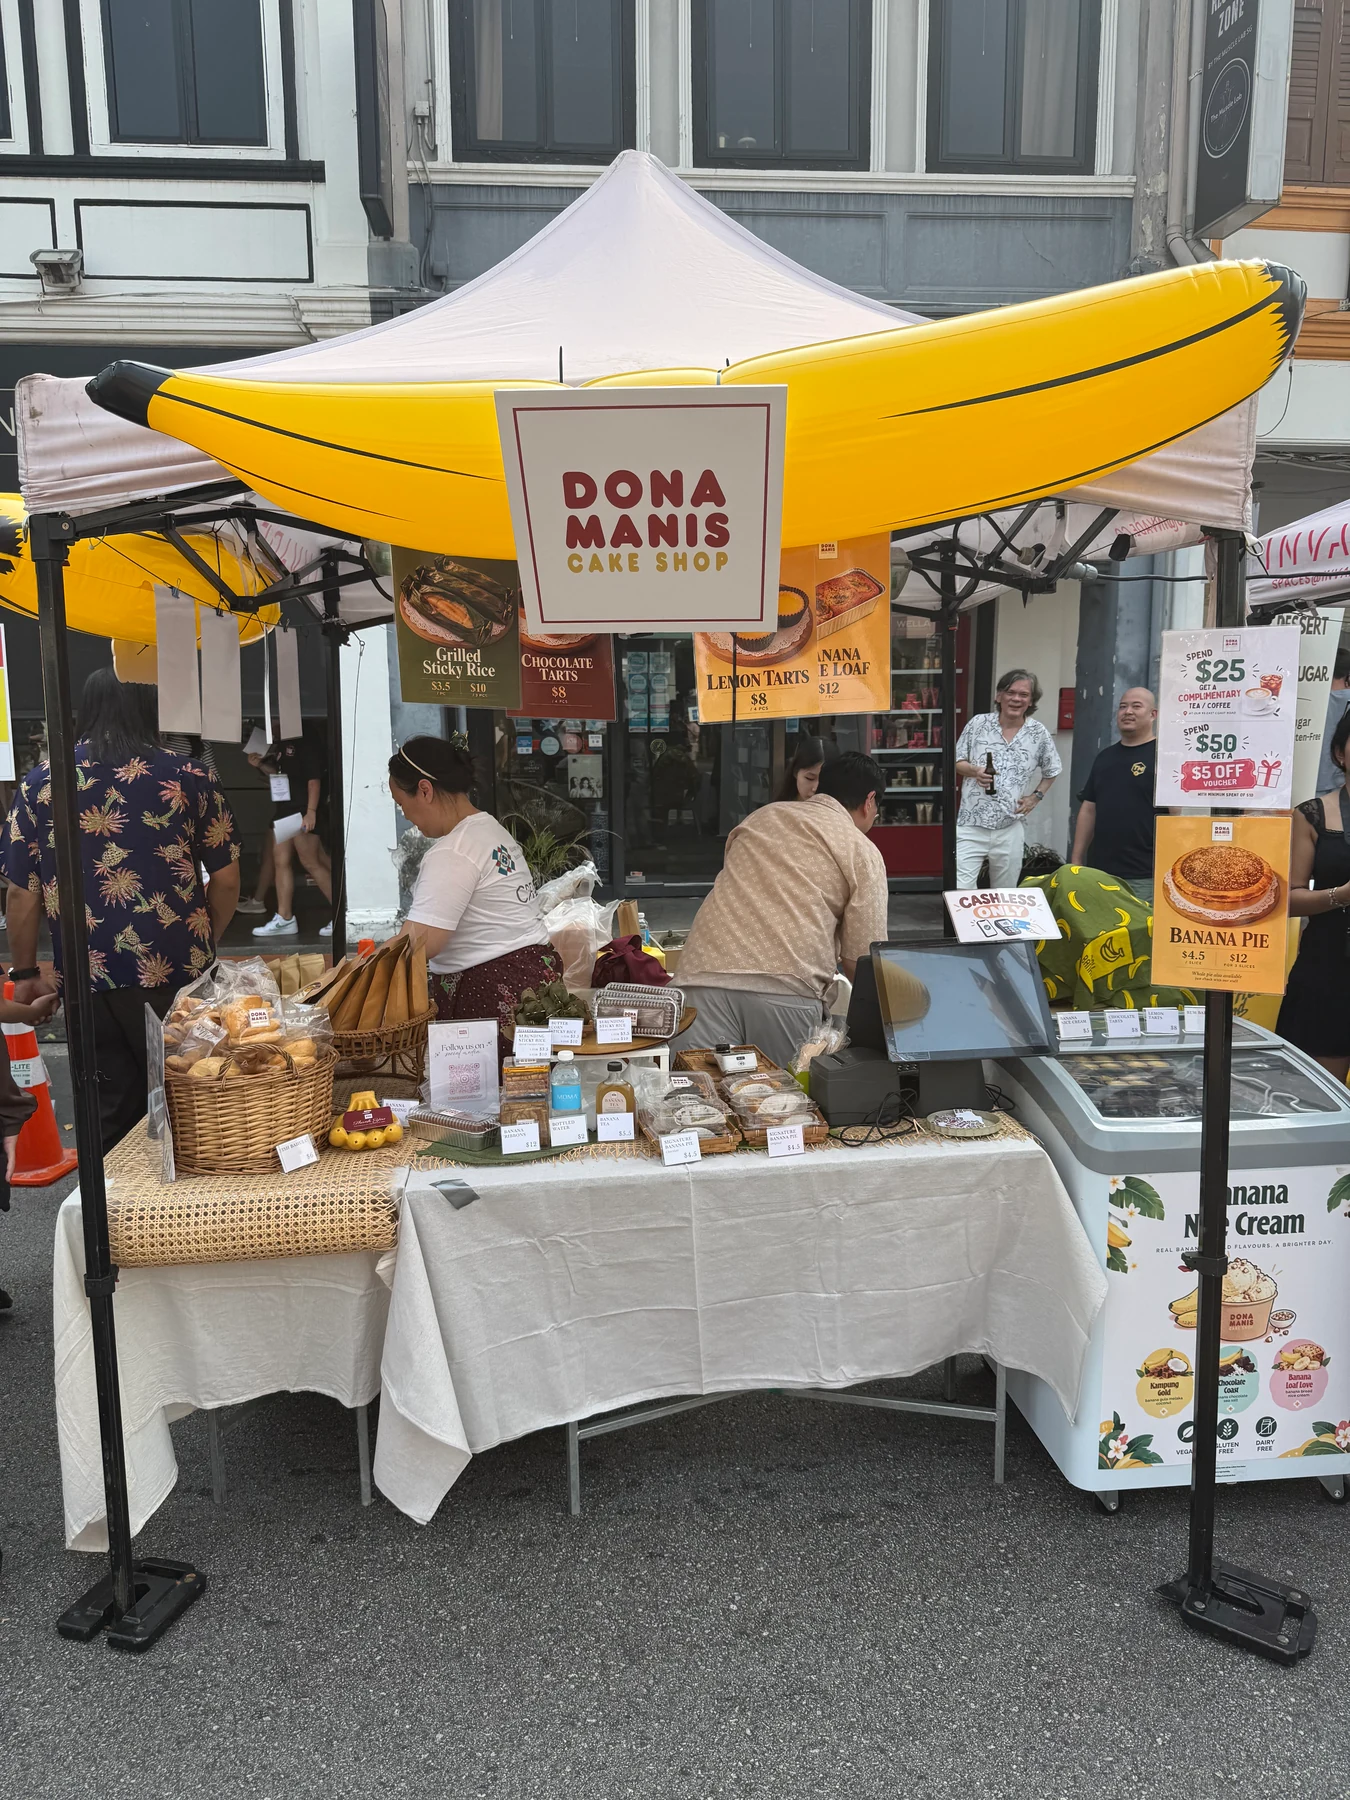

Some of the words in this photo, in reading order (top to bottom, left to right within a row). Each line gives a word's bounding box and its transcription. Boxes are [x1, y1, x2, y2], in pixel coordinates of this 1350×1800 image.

[562, 469, 726, 509] DONA
[566, 512, 730, 549] MANIS
[567, 552, 640, 573] CAKE
[656, 551, 728, 572] SHOP
[896, 620, 932, 628] WELLA
[436, 646, 482, 662] Grilled
[521, 654, 594, 669] CHOCOLATE
[818, 648, 861, 662] NANA
[1186, 649, 1213, 661] SPEND
[423, 660, 462, 678] Sticky
[466, 665, 496, 677] Rice
[539, 668, 578, 682] TARTS
[833, 662, 870, 676] LOAF
[1196, 658, 1245, 684] $25
[1298, 666, 1329, 682] UGAR.
[431, 680, 451, 691] $3.5
[470, 682, 487, 693] $10
[706, 673, 762, 690] LEMON
[763, 670, 810, 686] TARTS
[552, 686, 567, 699] $8
[751, 692, 767, 706] $8
[818, 682, 840, 695] $12
[1178, 690, 1241, 702] COMPLIMENTARY
[1184, 724, 1209, 736] SPEND
[1196, 734, 1237, 753] $50
[1192, 766, 1211, 780] $5
[1215, 764, 1245, 778] OFF
[1203, 778, 1237, 787] VOUCHER
[959, 892, 1037, 908] CASHLESS
[978, 906, 1026, 918] ONLY
[1170, 927, 1237, 947] BANANA
[1242, 932, 1269, 948] PIE
[1182, 950, 1205, 961] $4.5
[1230, 953, 1248, 963] $12
[1235, 1212, 1305, 1236] Cream
[1150, 1382, 1179, 1392] Kampung
[1158, 1388, 1171, 1397] Gold
